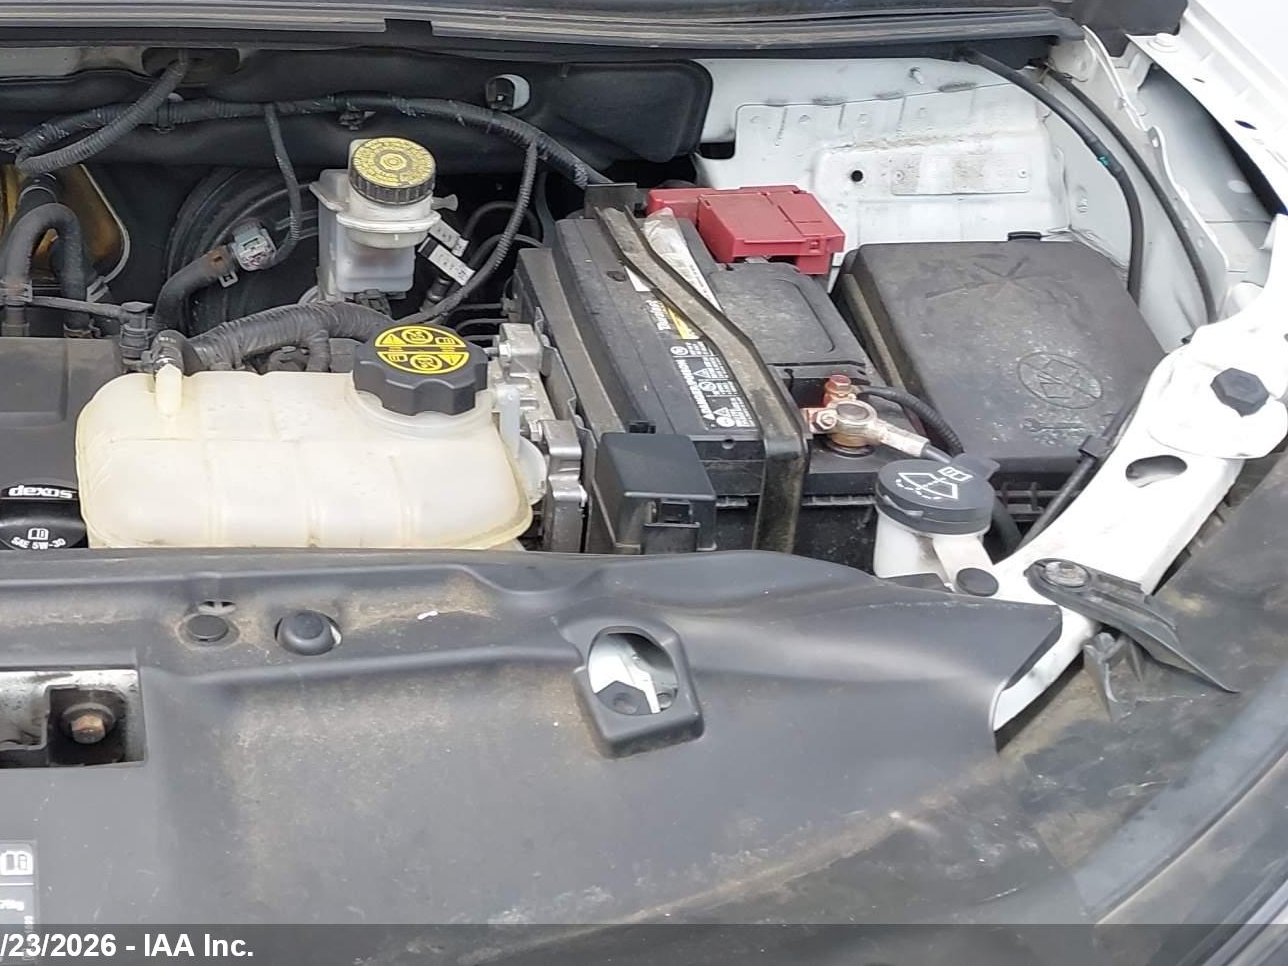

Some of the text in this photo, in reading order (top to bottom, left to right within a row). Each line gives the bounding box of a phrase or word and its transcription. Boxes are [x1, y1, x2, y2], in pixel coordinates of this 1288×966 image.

[8, 484, 73, 499] dexos
[11, 536, 67, 551] SAE 5W-30
